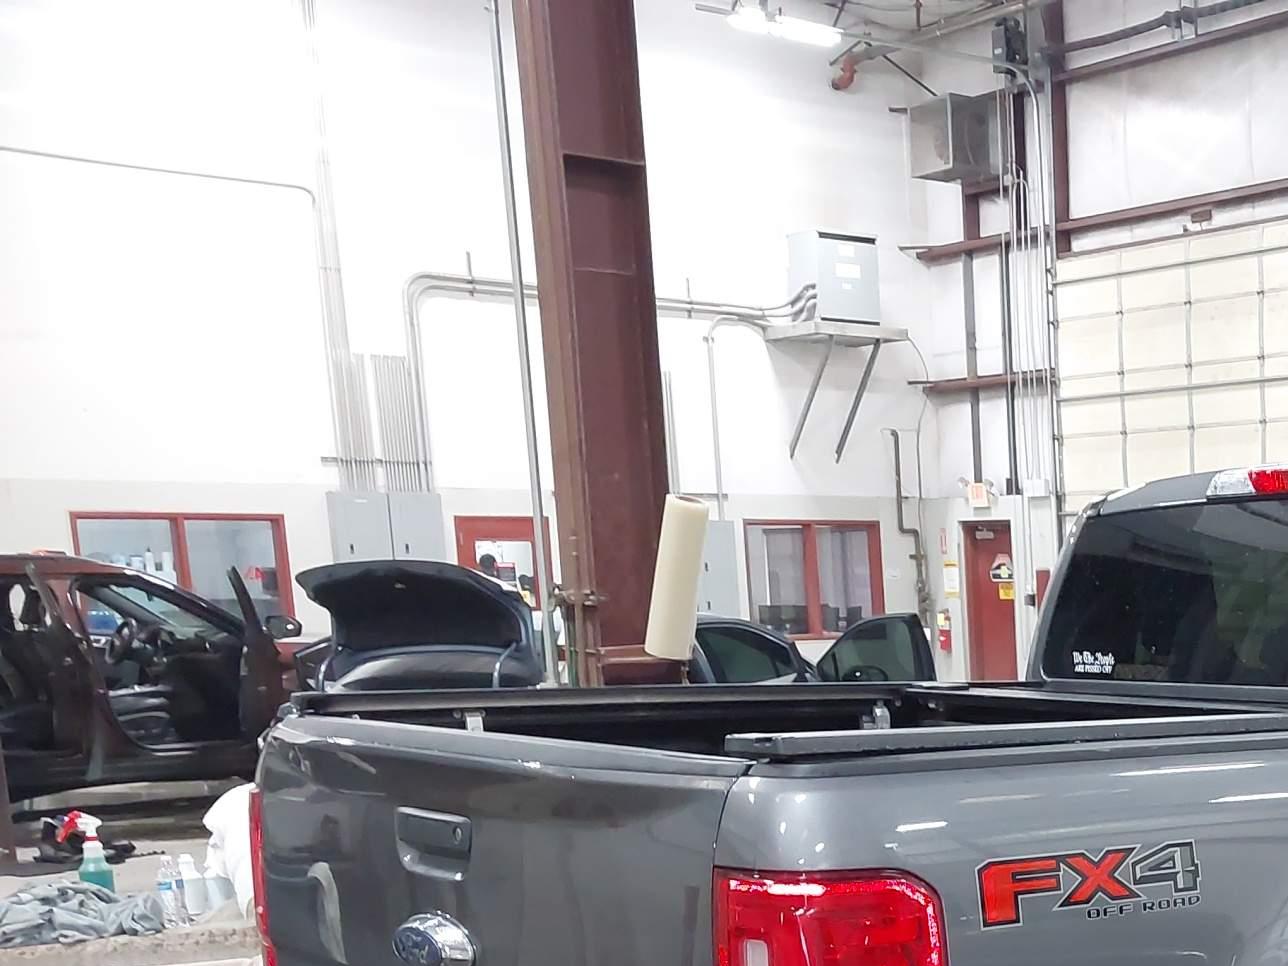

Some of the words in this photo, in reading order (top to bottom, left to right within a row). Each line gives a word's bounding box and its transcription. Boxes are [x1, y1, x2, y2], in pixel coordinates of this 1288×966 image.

[974, 838, 1202, 931] FX4
[1087, 903, 1133, 920] OFF
[1142, 895, 1201, 913] ROAD
